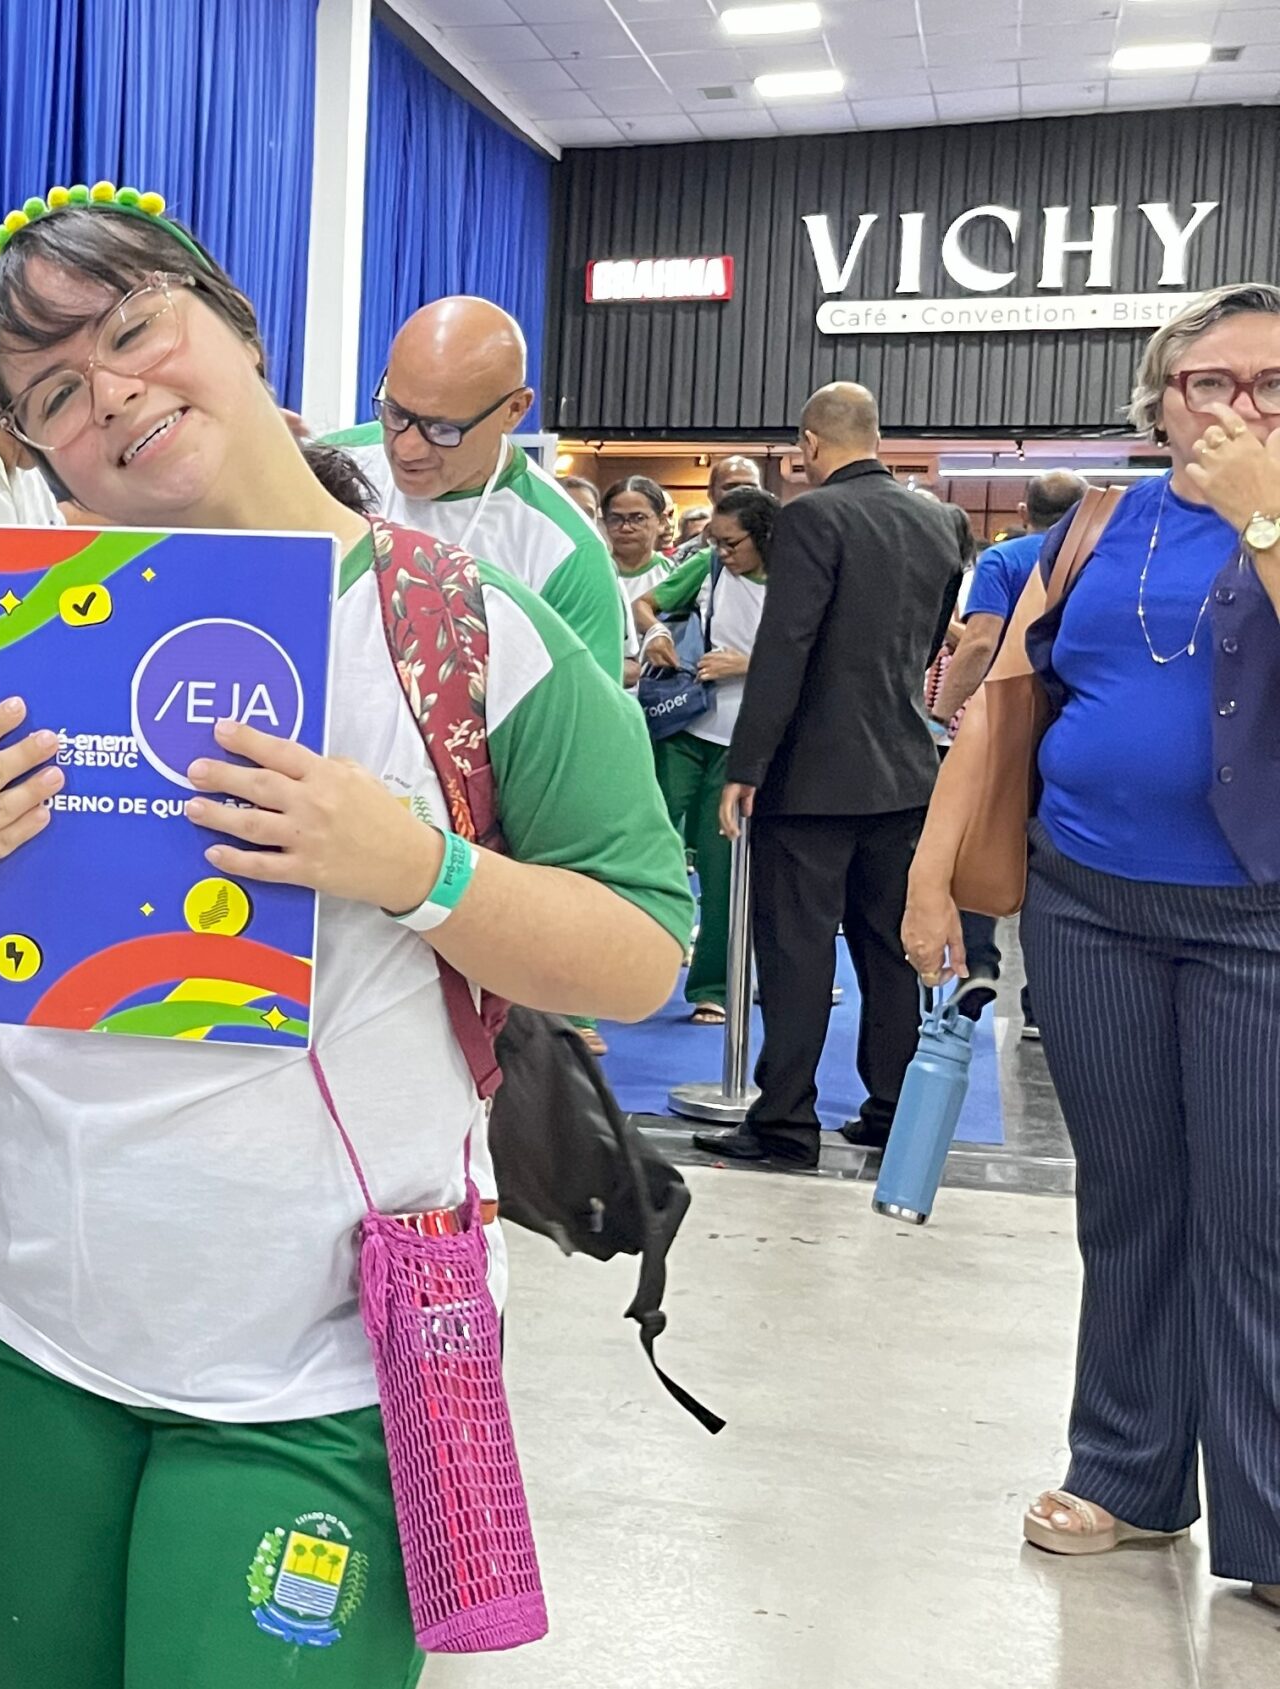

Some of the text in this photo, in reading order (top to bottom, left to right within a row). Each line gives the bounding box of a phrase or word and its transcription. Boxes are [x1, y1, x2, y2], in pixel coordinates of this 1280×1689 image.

[801, 202, 1220, 294] VICHY
[829, 301, 1192, 327] Café Convention Bistr
[153, 681, 280, 726] /EJA
[644, 693, 688, 717] opper
[55, 727, 138, 753] é-enem
[73, 750, 139, 769] SEDUC
[42, 794, 115, 813] DERNO
[118, 797, 148, 815] DE
